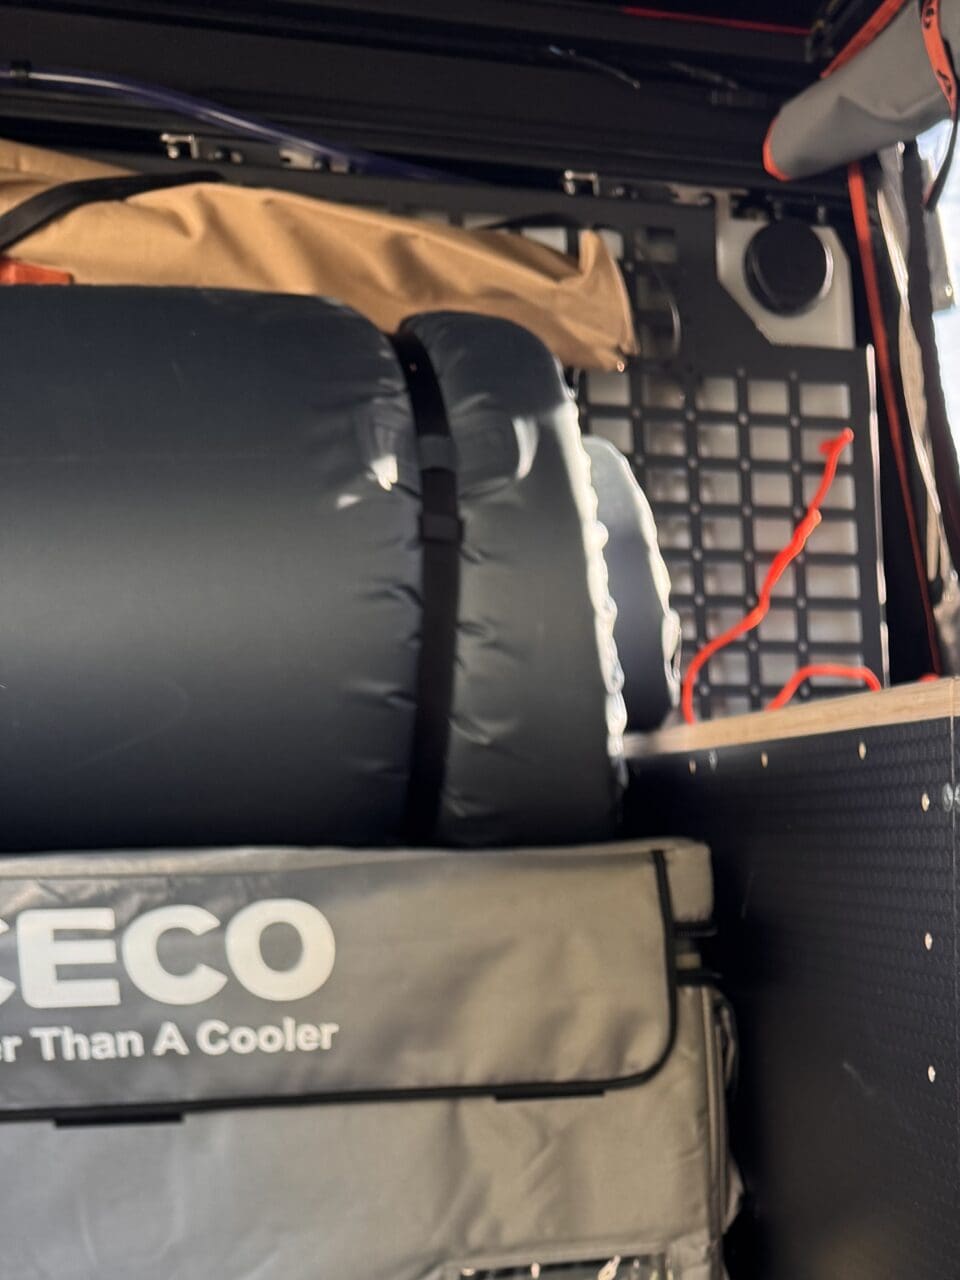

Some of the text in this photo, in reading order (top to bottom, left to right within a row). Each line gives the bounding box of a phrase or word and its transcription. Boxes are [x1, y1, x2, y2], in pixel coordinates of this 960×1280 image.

[0, 897, 337, 1009] ECO
[0, 1016, 340, 1063] r Than A Cooler
